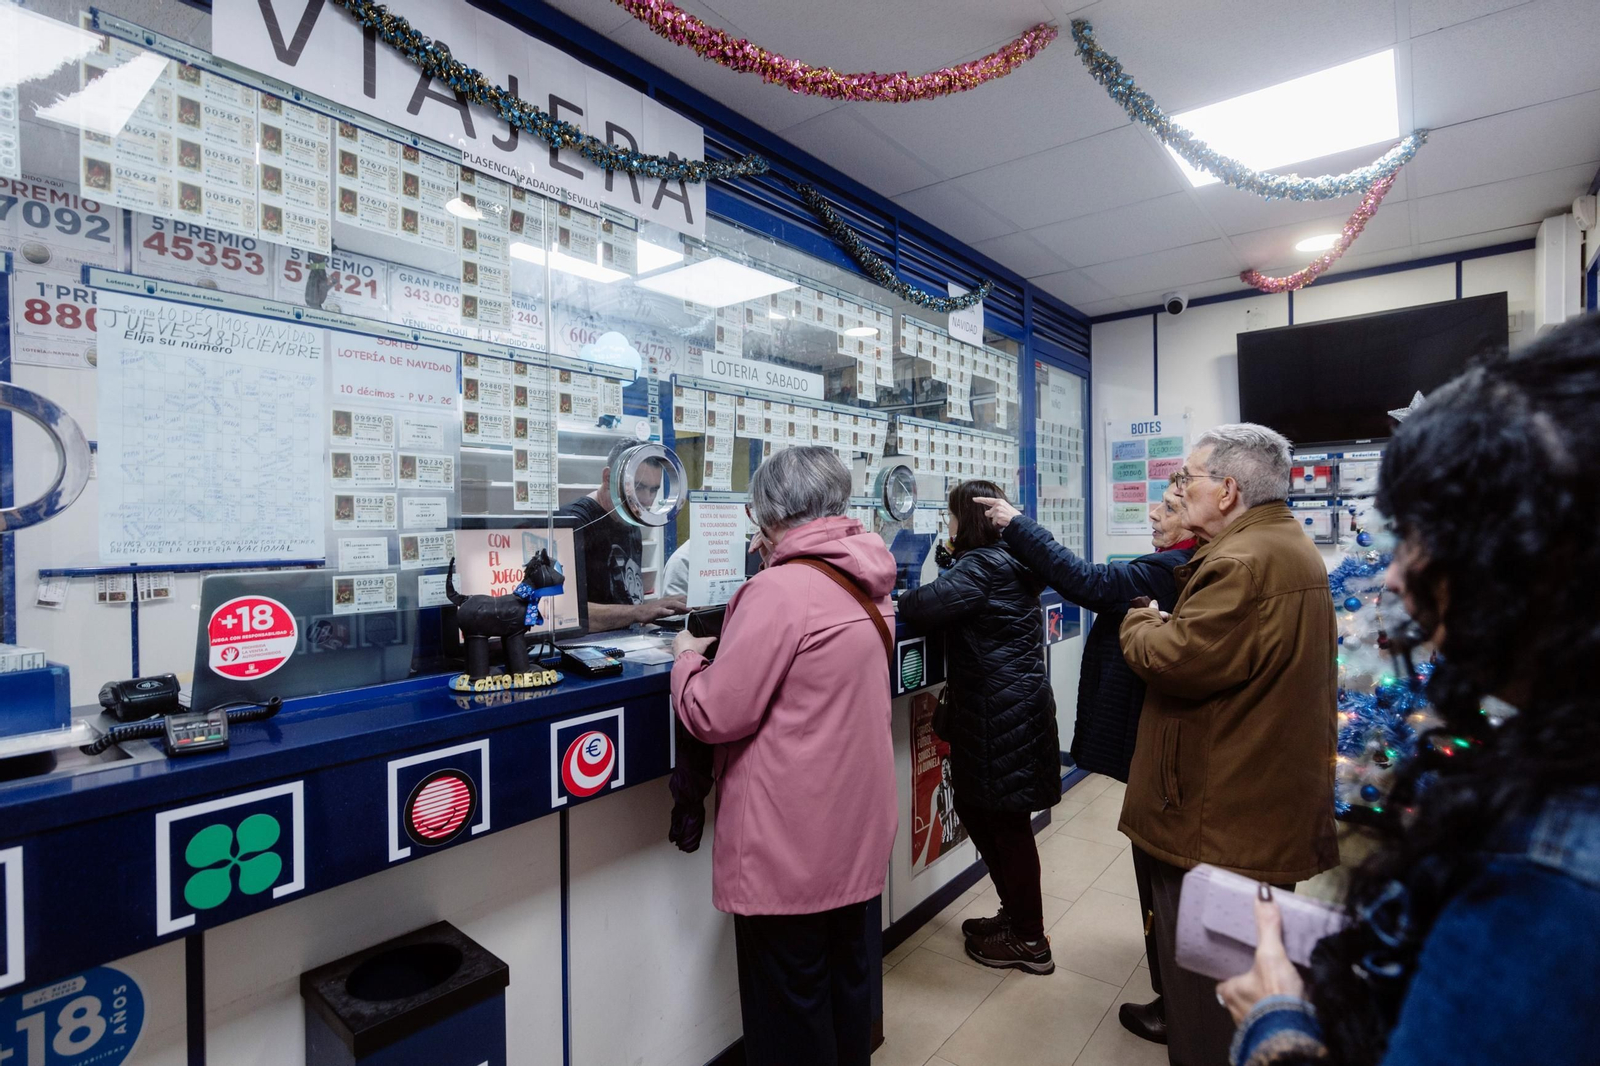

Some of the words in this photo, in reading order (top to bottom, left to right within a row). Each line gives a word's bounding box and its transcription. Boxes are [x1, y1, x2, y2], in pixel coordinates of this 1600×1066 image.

[204, 106, 241, 124] 00586
[258, 0, 694, 224] VIAJERA
[124, 124, 157, 140] 0624
[204, 149, 241, 165] 00586
[359, 158, 388, 173] 67670
[115, 167, 157, 183] 00624
[463, 151, 517, 178] PLASENCIA
[567, 191, 599, 211] SEVILLA
[205, 190, 241, 206] 00586
[359, 195, 388, 209] 67670
[174, 219, 257, 251] PREMIO
[143, 231, 265, 276] 45353
[283, 259, 377, 300] 5421
[399, 272, 430, 288] GRAN
[404, 286, 460, 308] 343.003
[157, 305, 177, 323] 10
[402, 317, 443, 333] VENDIDO
[446, 325, 468, 337] AQUÍ
[570, 327, 603, 345] 606
[123, 329, 155, 345] Elija
[158, 336, 176, 347] su
[181, 339, 233, 355] número
[376, 337, 419, 351] SORTEO
[494, 335, 528, 348] VDIDO
[530, 342, 546, 351] AQU
[634, 341, 672, 361] 74778
[338, 347, 386, 364] LOTERÍA
[390, 356, 403, 366] DE
[406, 359, 452, 374] NAVIDAD
[711, 359, 759, 382] LOTERIA
[766, 371, 809, 392] SABADO
[340, 384, 353, 394] 10
[357, 384, 395, 399] décimos
[409, 392, 436, 405] P.V.P.
[440, 396, 453, 405] 2€
[1131, 421, 1162, 436] BOTES
[236, 545, 294, 553] NACIONAL
[488, 533, 511, 549] CON
[488, 551, 501, 567] EL
[699, 569, 730, 577] PAPELETA
[220, 604, 275, 632] +18
[241, 630, 287, 640] RESPONSABILIDAD
[455, 674, 471, 691] EL
[474, 673, 513, 692] GATO
[513, 669, 559, 688] NEGRO
[110, 984, 127, 1035] AÑOS
